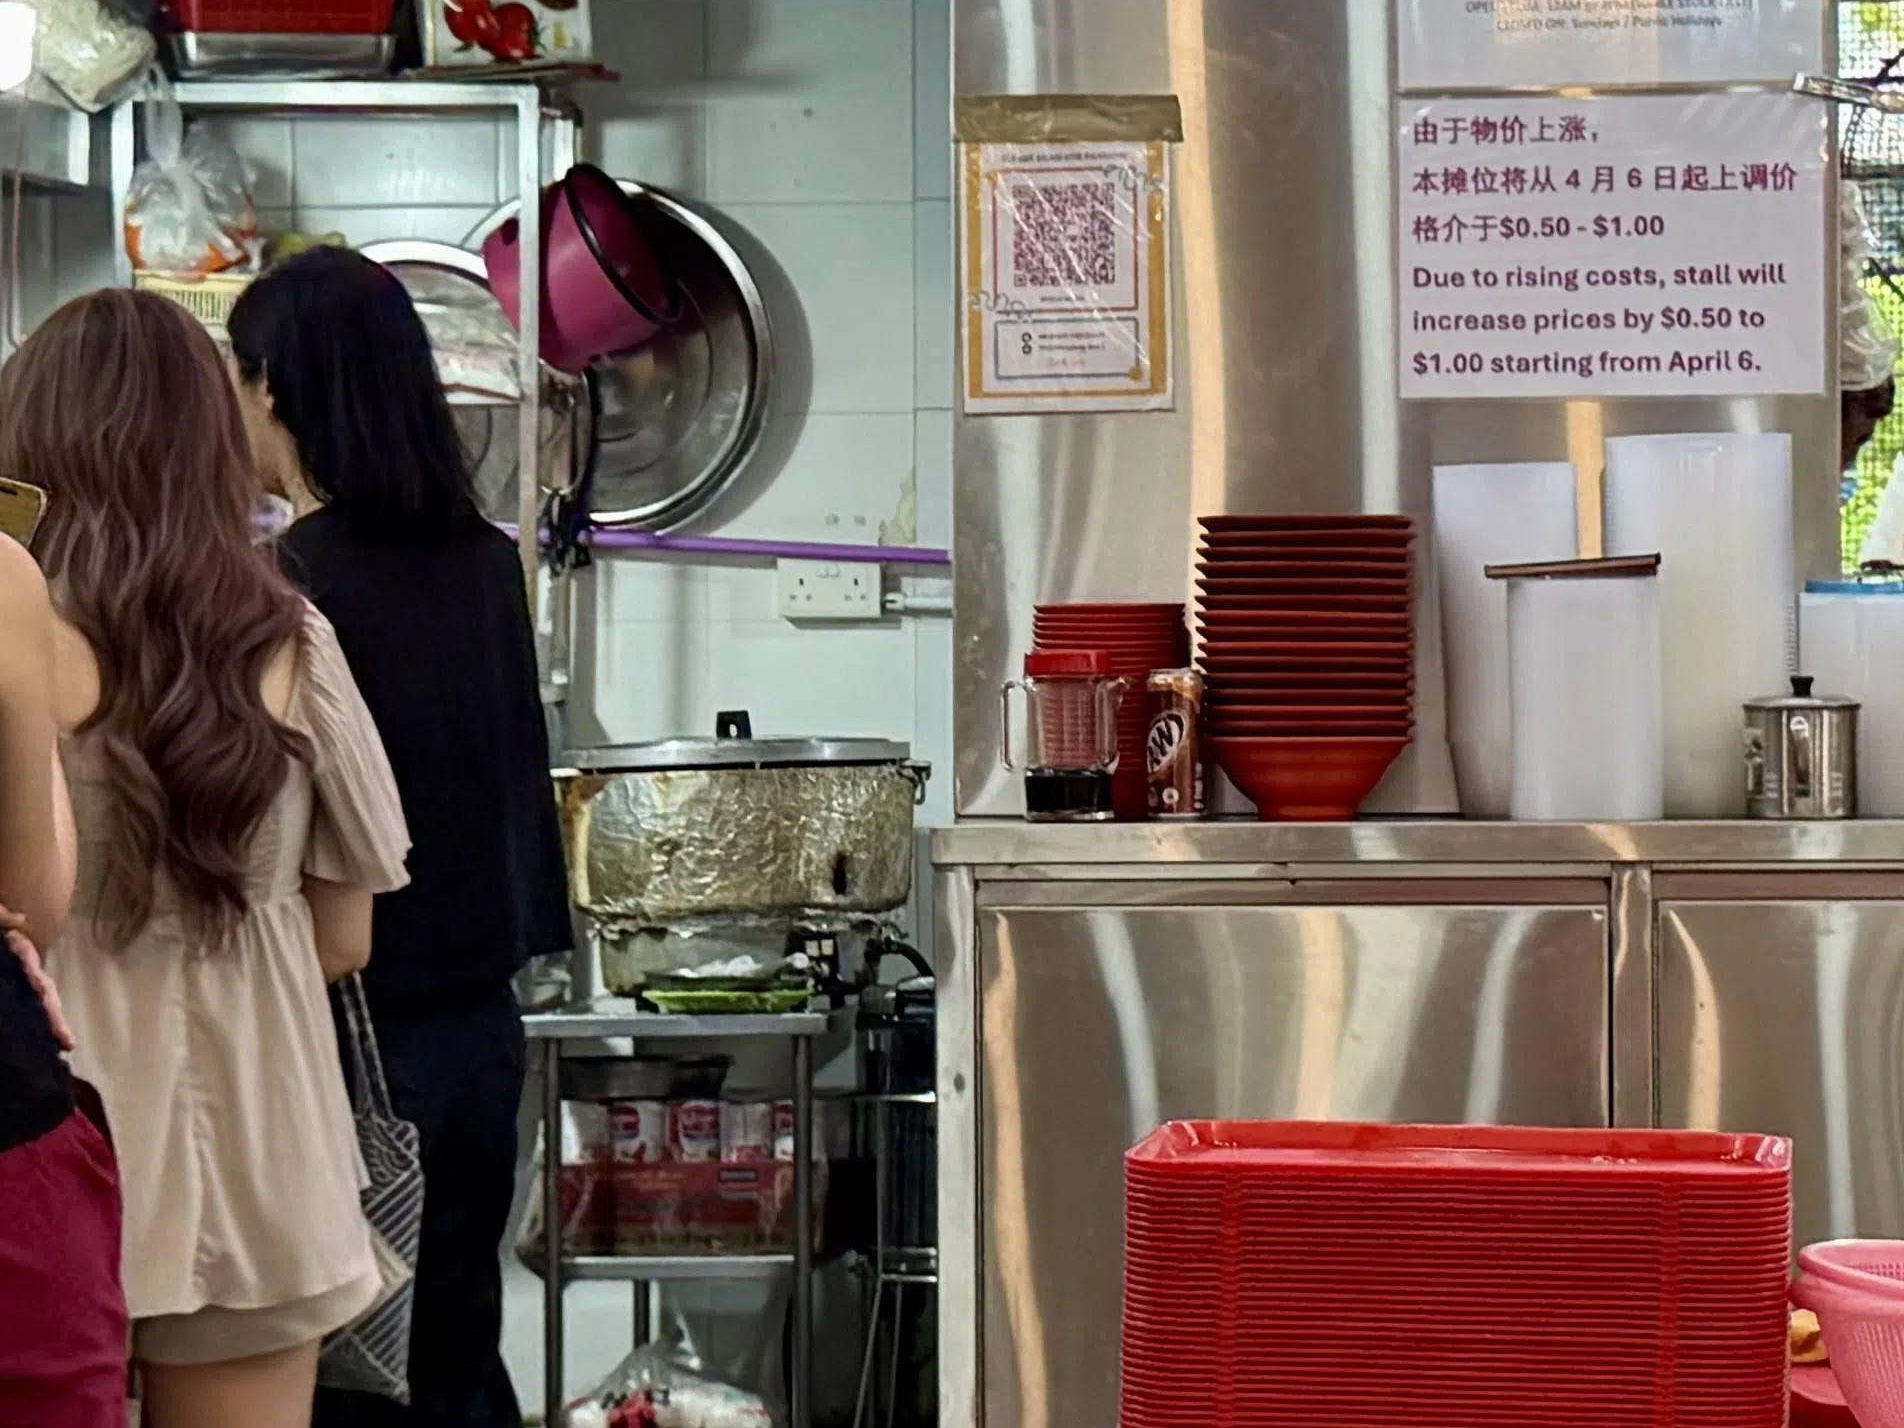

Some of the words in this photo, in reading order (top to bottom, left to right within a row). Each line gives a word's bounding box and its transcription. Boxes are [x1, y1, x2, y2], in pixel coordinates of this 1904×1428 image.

[1412, 166, 1557, 196] 本摊位将从
[1565, 169, 1581, 189] 4
[1591, 166, 1614, 193] 月
[1627, 168, 1643, 189] 6
[1654, 162, 1798, 192] 日起上调价
[1592, 214, 1665, 240] $1.00
[1413, 267, 1466, 288] Due
[1472, 268, 1499, 288] to
[1505, 266, 1579, 292] rising
[1585, 266, 1666, 290] costs,
[1673, 263, 1732, 286] stall
[1738, 263, 1787, 285] will
[1413, 310, 1527, 332] increase
[1533, 308, 1617, 335] prices
[1623, 308, 1654, 334] by
[1660, 306, 1732, 331] $0.50
[1738, 309, 1766, 328] to
[1413, 351, 1484, 376] $1.00
[1490, 351, 1594, 378] starting
[1599, 350, 1662, 372] from
[1668, 350, 1732, 377] April
[1738, 350, 1762, 371] 6.
